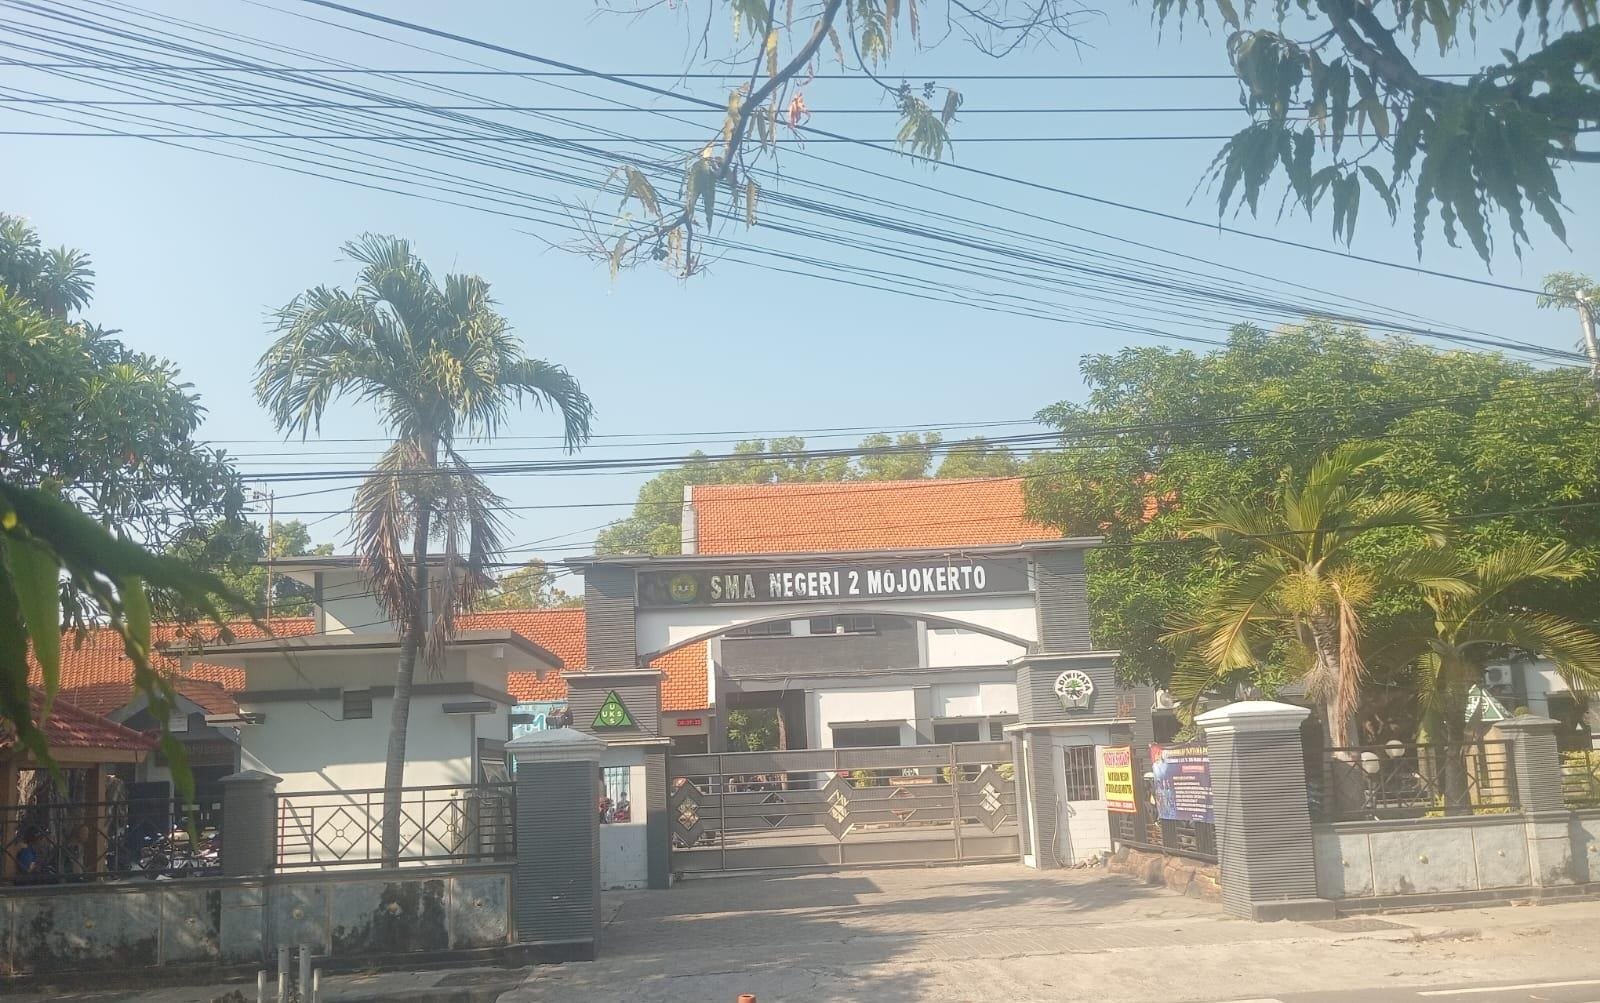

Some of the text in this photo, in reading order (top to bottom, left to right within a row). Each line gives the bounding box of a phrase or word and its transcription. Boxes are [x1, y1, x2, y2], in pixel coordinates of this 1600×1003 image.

[710, 565, 986, 600] SMA NEGERI 2 MOJOKERTO
[1057, 672, 1091, 692] ADIWIYATA
